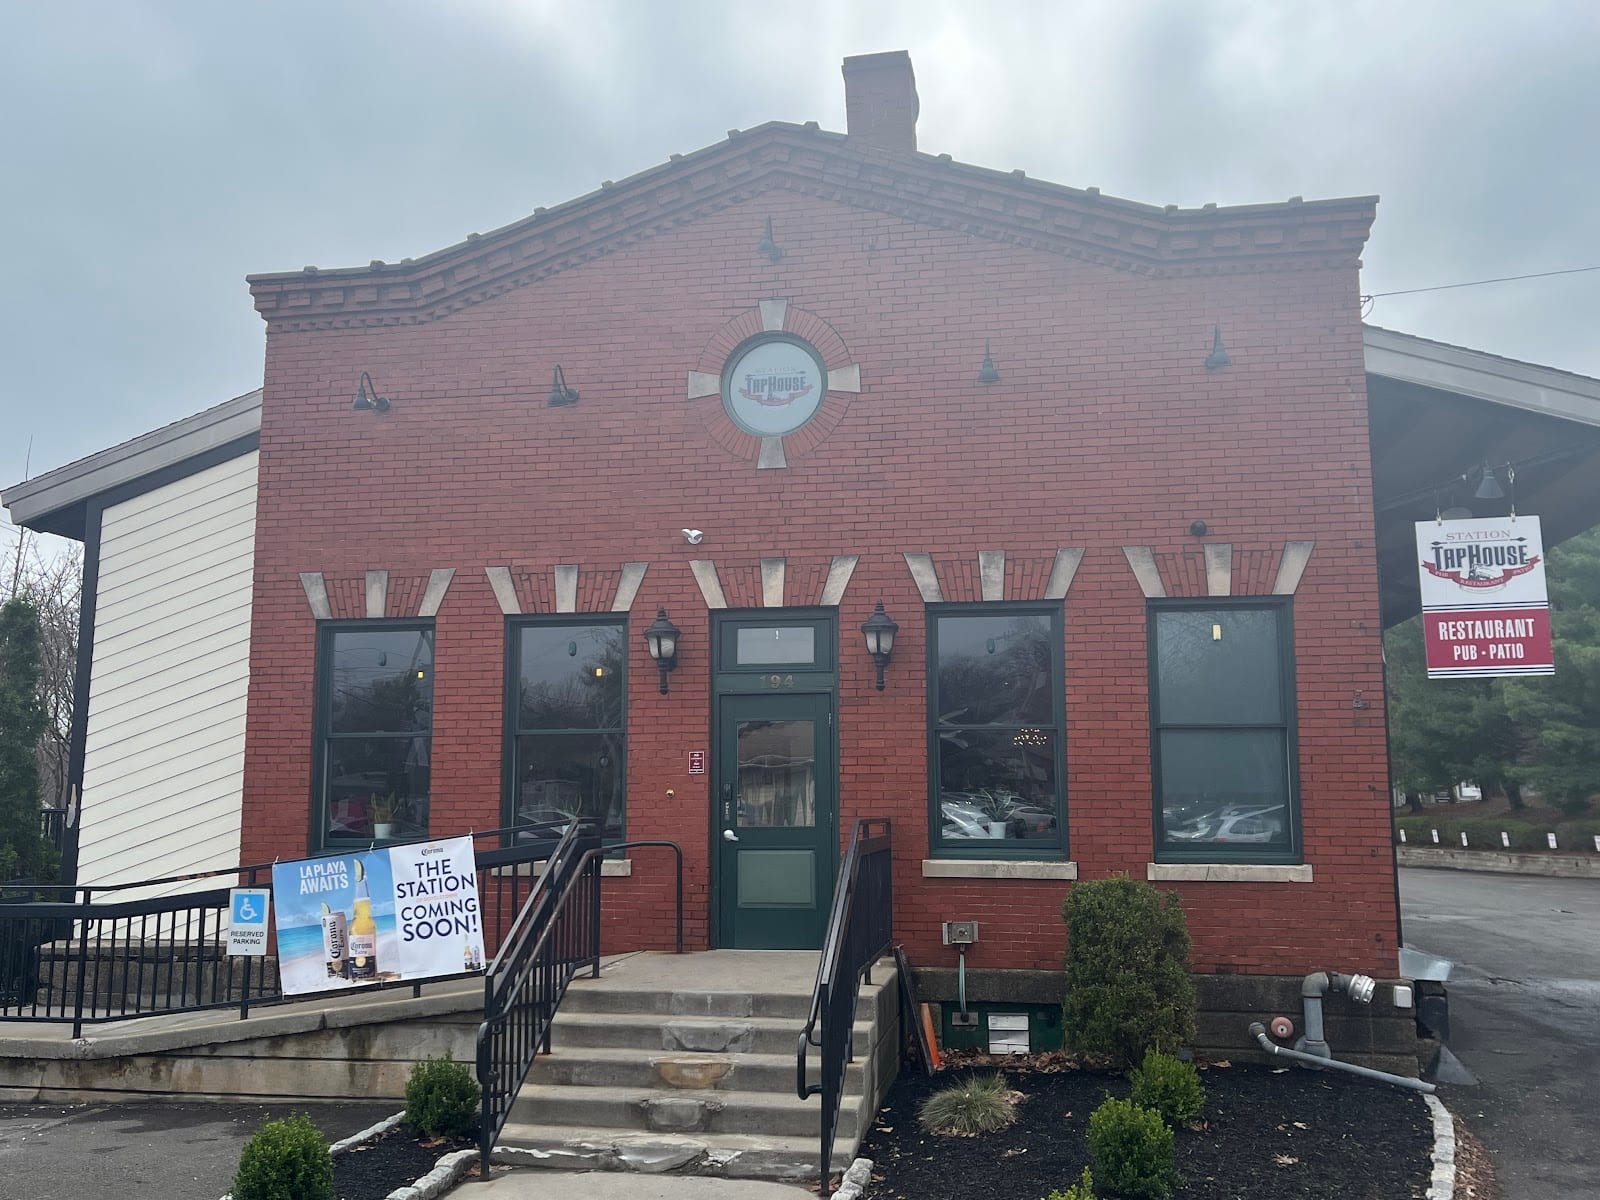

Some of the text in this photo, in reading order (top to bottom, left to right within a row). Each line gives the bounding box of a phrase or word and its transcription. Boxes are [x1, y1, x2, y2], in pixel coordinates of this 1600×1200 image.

[1446, 530, 1511, 540] STATION
[1438, 618, 1535, 641] RESTAURANT
[1453, 643, 1524, 660] PUB PATIO
[759, 673, 794, 689] 194
[421, 847, 444, 857] Corona
[300, 860, 347, 879] LA PLAYA
[414, 859, 452, 878] THE
[300, 873, 349, 895] AWAITS
[396, 872, 475, 898] STATION
[401, 898, 477, 922] COMING
[402, 914, 478, 942] SOON!
